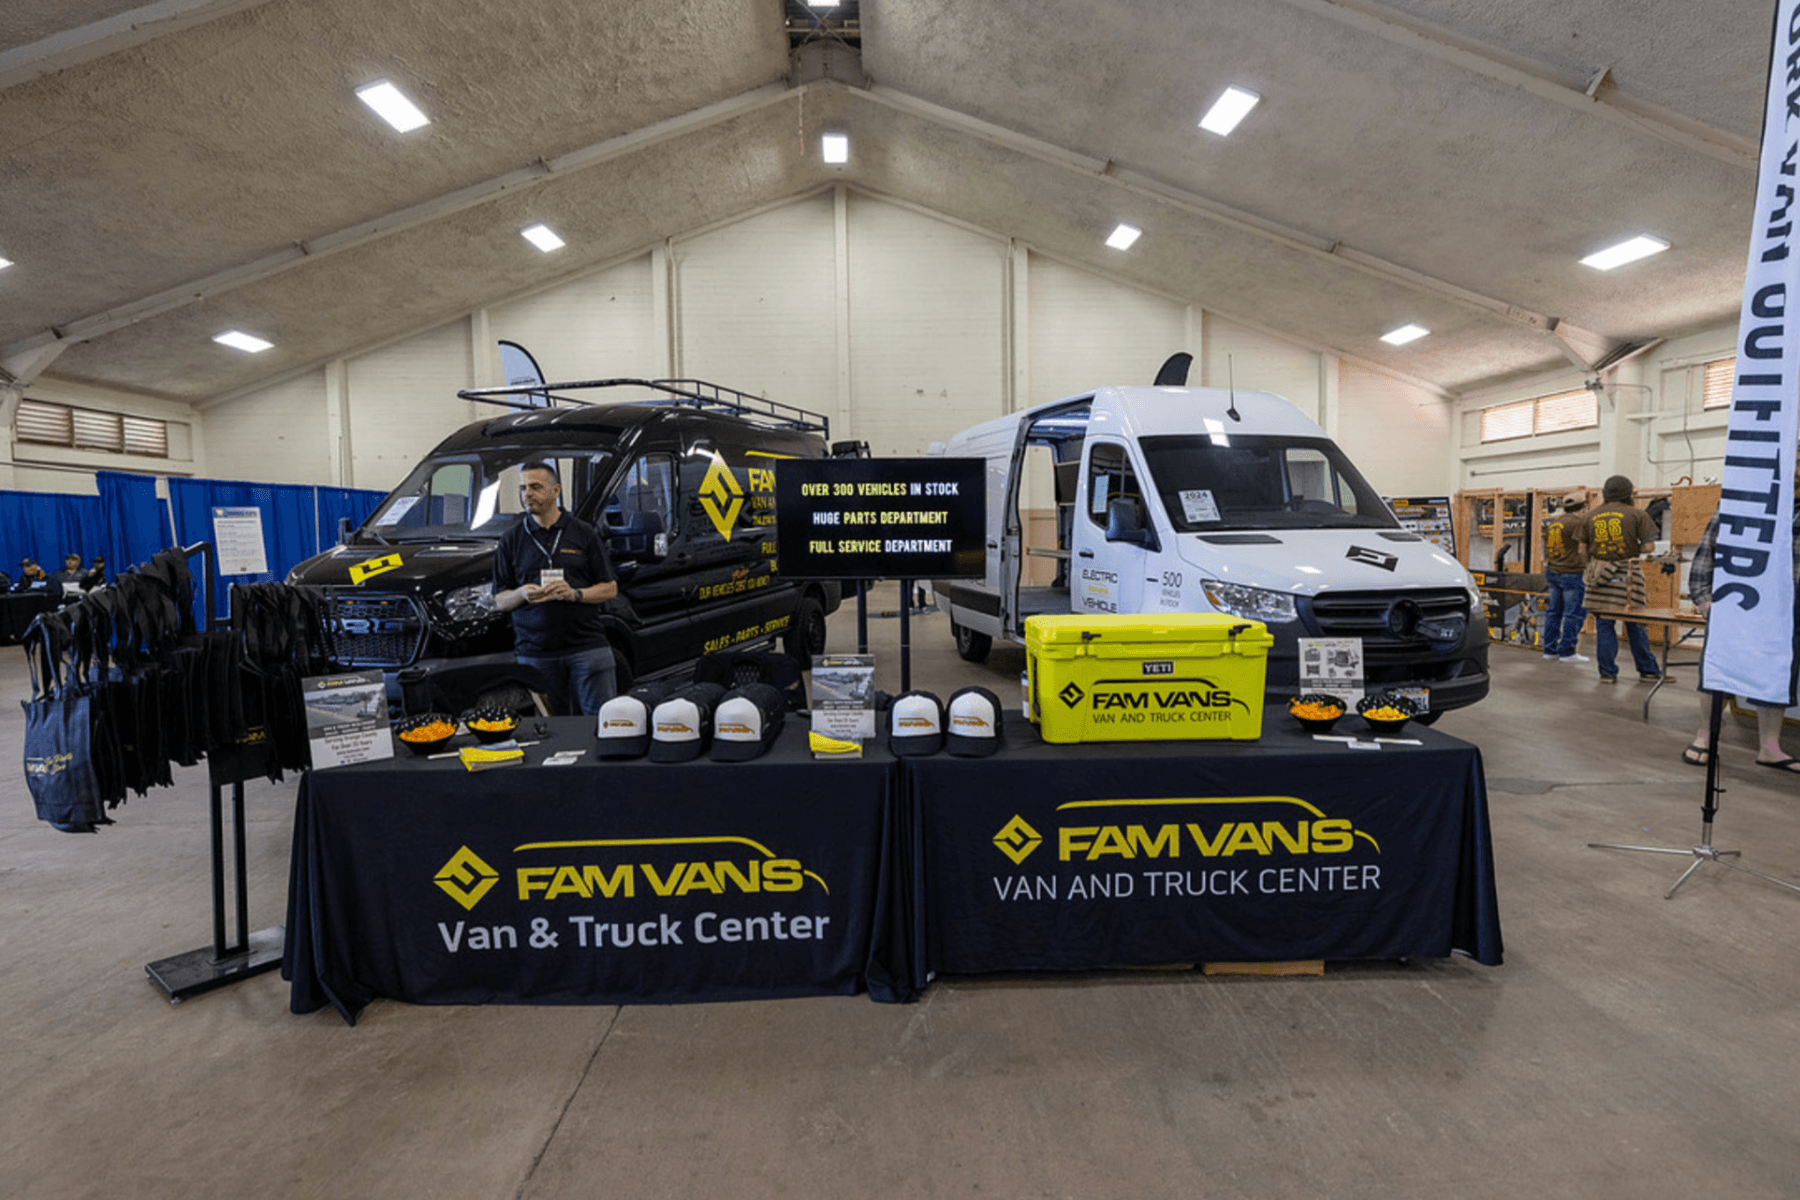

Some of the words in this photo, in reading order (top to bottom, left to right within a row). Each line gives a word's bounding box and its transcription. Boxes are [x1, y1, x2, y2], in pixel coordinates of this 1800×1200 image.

[801, 483, 830, 496] OVER
[834, 483, 854, 496] 300
[858, 483, 907, 496] VEHICLES
[910, 483, 921, 495] IN
[925, 482, 959, 495] STOCK
[812, 512, 840, 525] HUGE
[843, 511, 877, 524] PARTS
[880, 511, 948, 524] DEPARTMENT
[809, 540, 834, 554] FULL
[838, 540, 881, 553] SERVICE
[884, 540, 953, 553] DEPARTMENT
[1082, 569, 1118, 584] ELECTRIC
[1162, 571, 1182, 587] 500
[1081, 597, 1118, 613] VEHICLE
[703, 635, 730, 655] SALES
[736, 625, 760, 643] PARTS
[1144, 664, 1173, 674] YETI
[1093, 693, 1149, 709] FAM
[1154, 691, 1231, 708] VANS
[1092, 713, 1115, 723] VAN
[1121, 712, 1145, 723] AND
[1150, 712, 1185, 722] TRUCK
[1190, 711, 1232, 722] CENTER
[1058, 824, 1180, 861] FAM
[1187, 818, 1354, 857] VANS
[516, 864, 634, 900] FAM
[639, 859, 804, 896] VANS
[993, 875, 1056, 901] VAN
[1068, 873, 1134, 901] AND
[1143, 870, 1249, 897] TRUCK
[1258, 865, 1381, 894] CENTER
[438, 920, 518, 953] Van
[529, 917, 559, 948] &
[570, 914, 684, 947] Truck
[694, 911, 830, 943] Center
